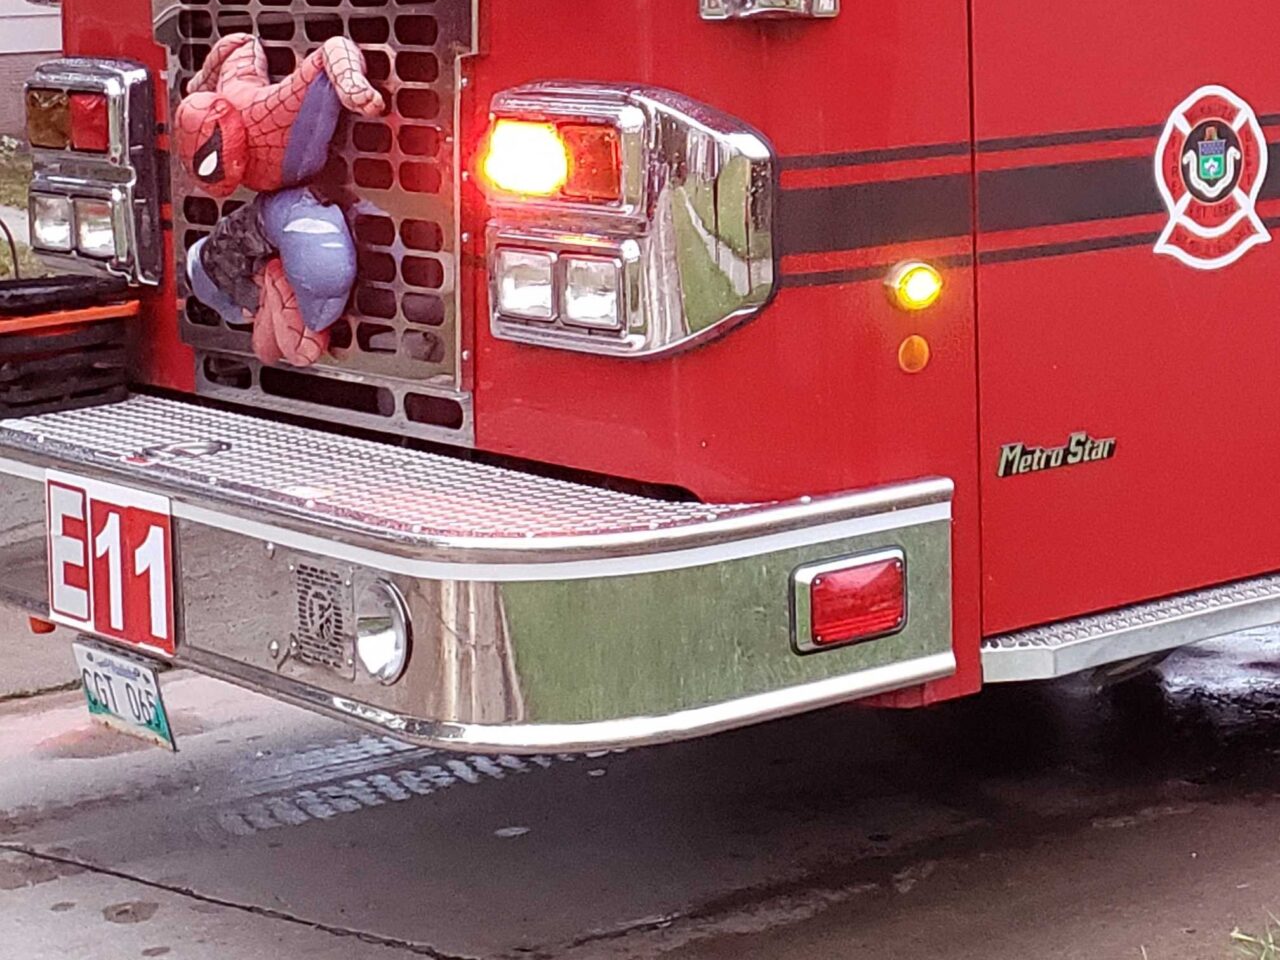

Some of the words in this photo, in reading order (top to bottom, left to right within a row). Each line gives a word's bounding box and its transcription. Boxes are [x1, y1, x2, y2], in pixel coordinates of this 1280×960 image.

[998, 444, 1064, 478] Metro
[1066, 430, 1116, 465] Star
[49, 483, 168, 639] E11
[82, 667, 119, 713] CGT
